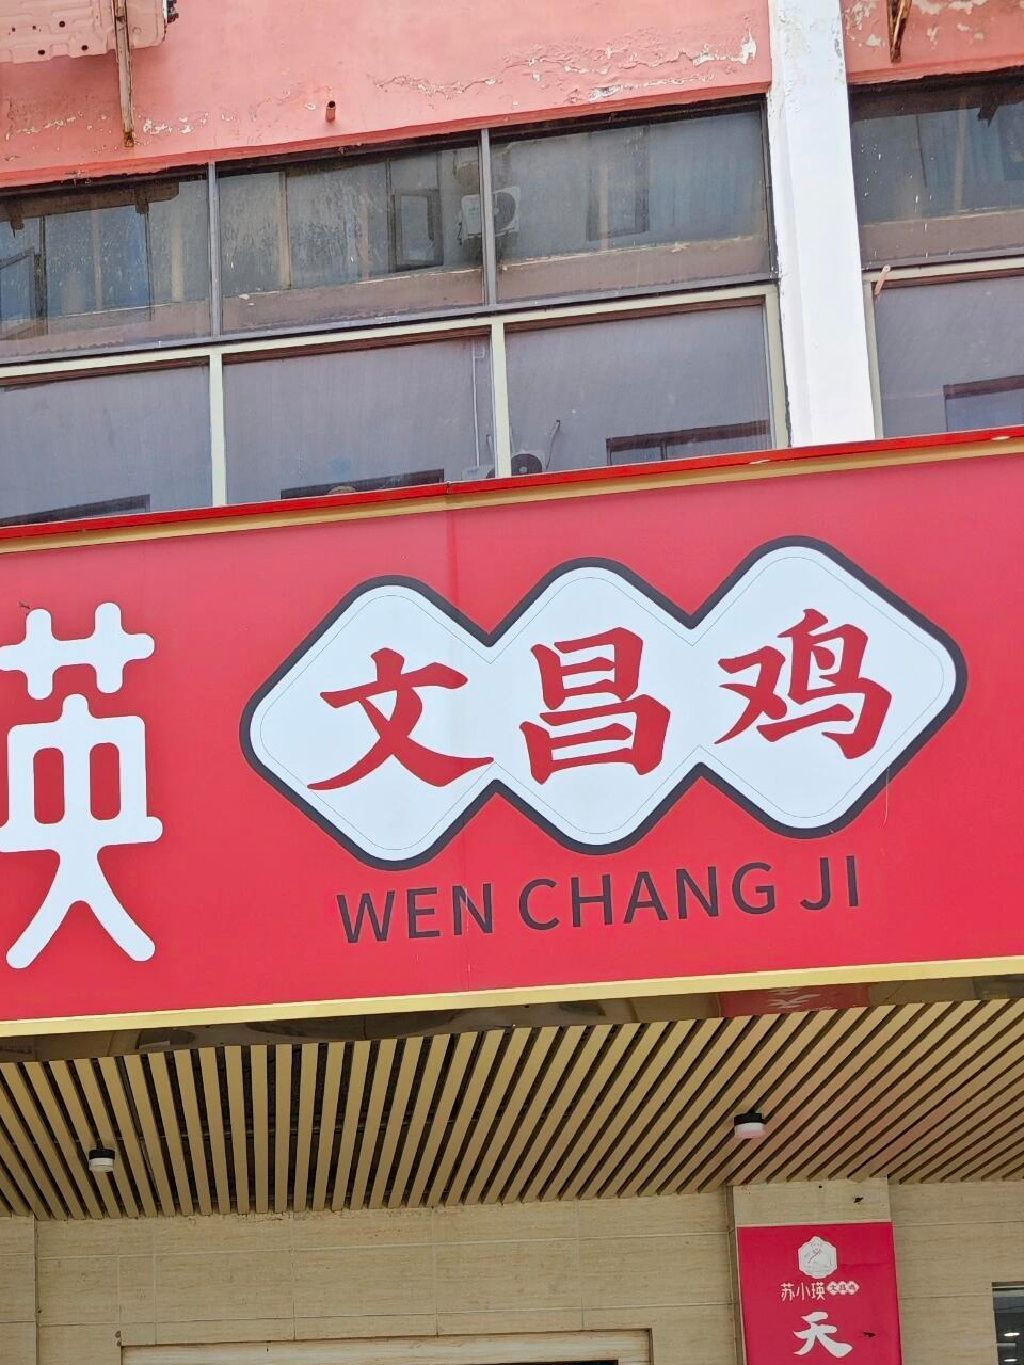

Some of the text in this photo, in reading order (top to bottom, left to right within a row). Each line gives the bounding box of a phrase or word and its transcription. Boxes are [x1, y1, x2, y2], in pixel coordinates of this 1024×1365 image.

[307, 608, 892, 791] 文昌鸡
[336, 854, 860, 944] WEN CHANG JI
[780, 1282, 826, 1301] 苏小瑛
